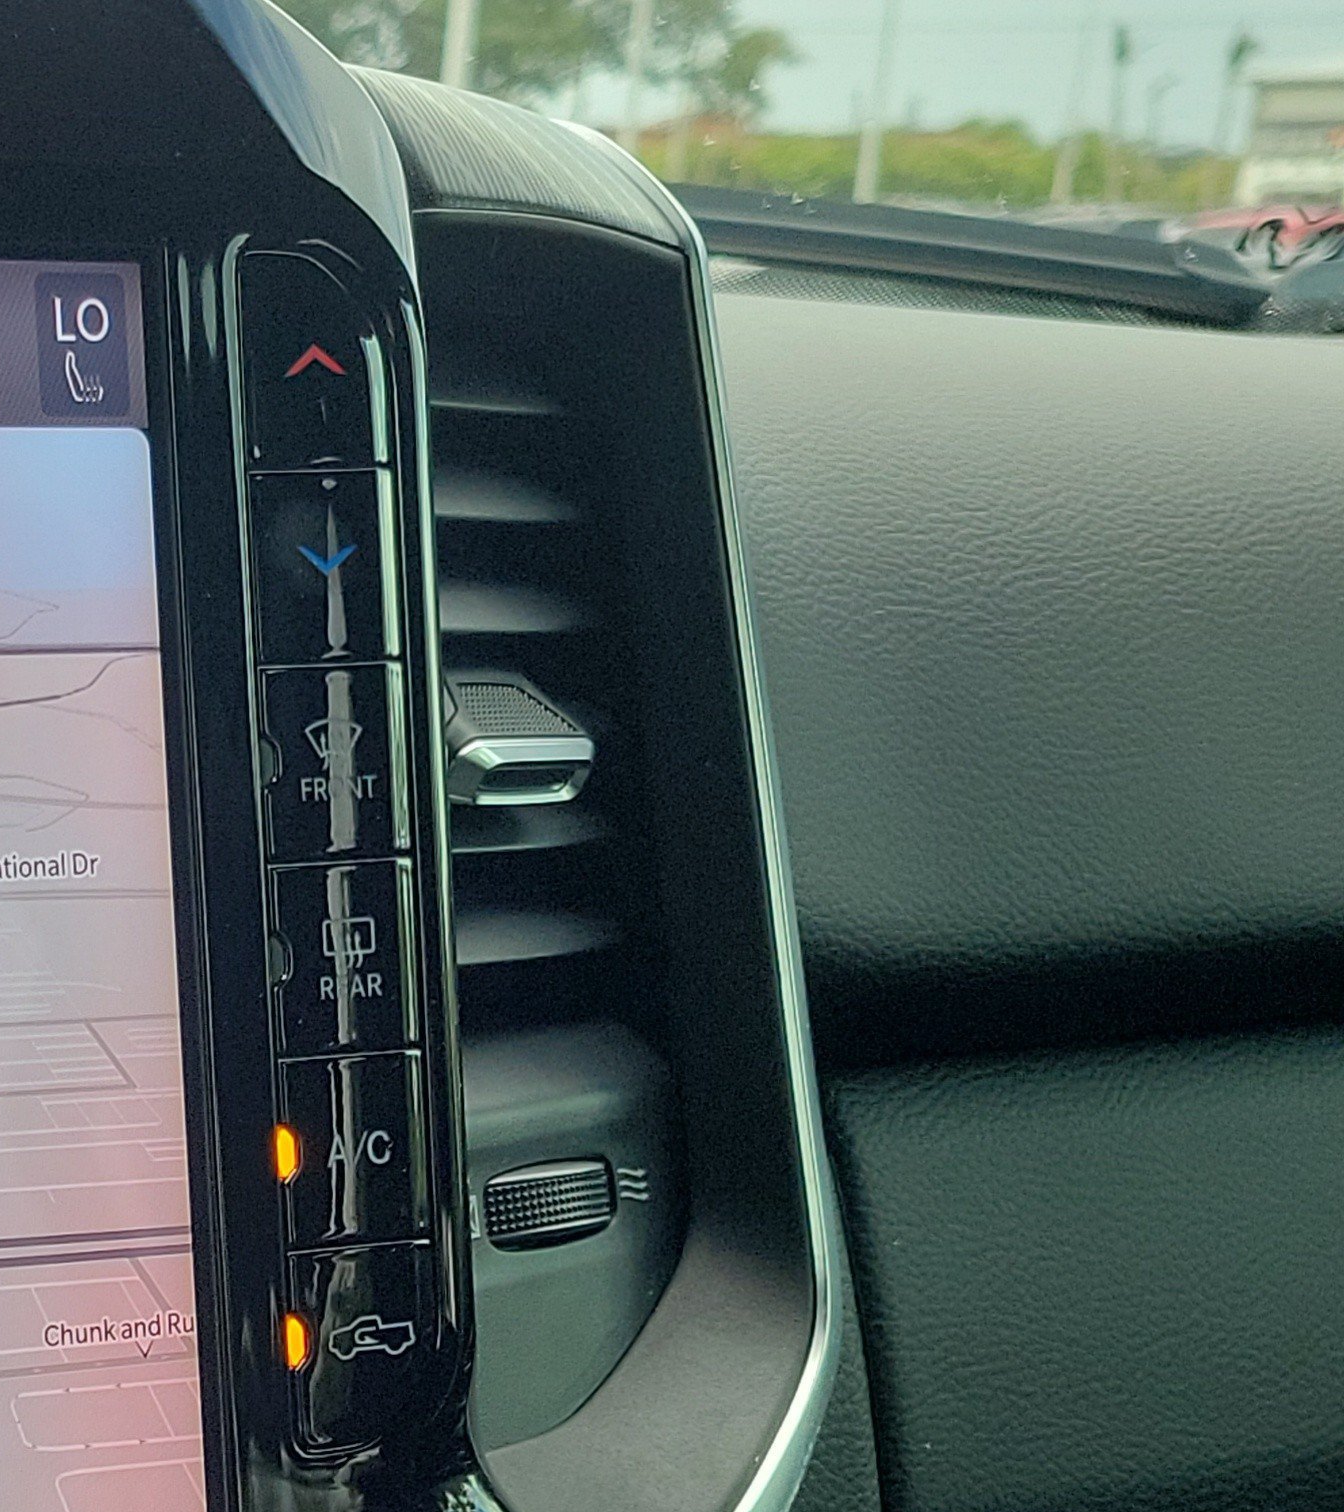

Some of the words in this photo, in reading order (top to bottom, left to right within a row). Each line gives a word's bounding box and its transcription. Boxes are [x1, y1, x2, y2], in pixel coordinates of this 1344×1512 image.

[53, 296, 110, 343] LO
[72, 852, 99, 876] Dr
[319, 972, 383, 1001] RAR
[327, 1130, 393, 1168] A/C
[44, 1319, 116, 1346] Chunk
[121, 1314, 160, 1339] and
[168, 1312, 194, 1334] Ru
